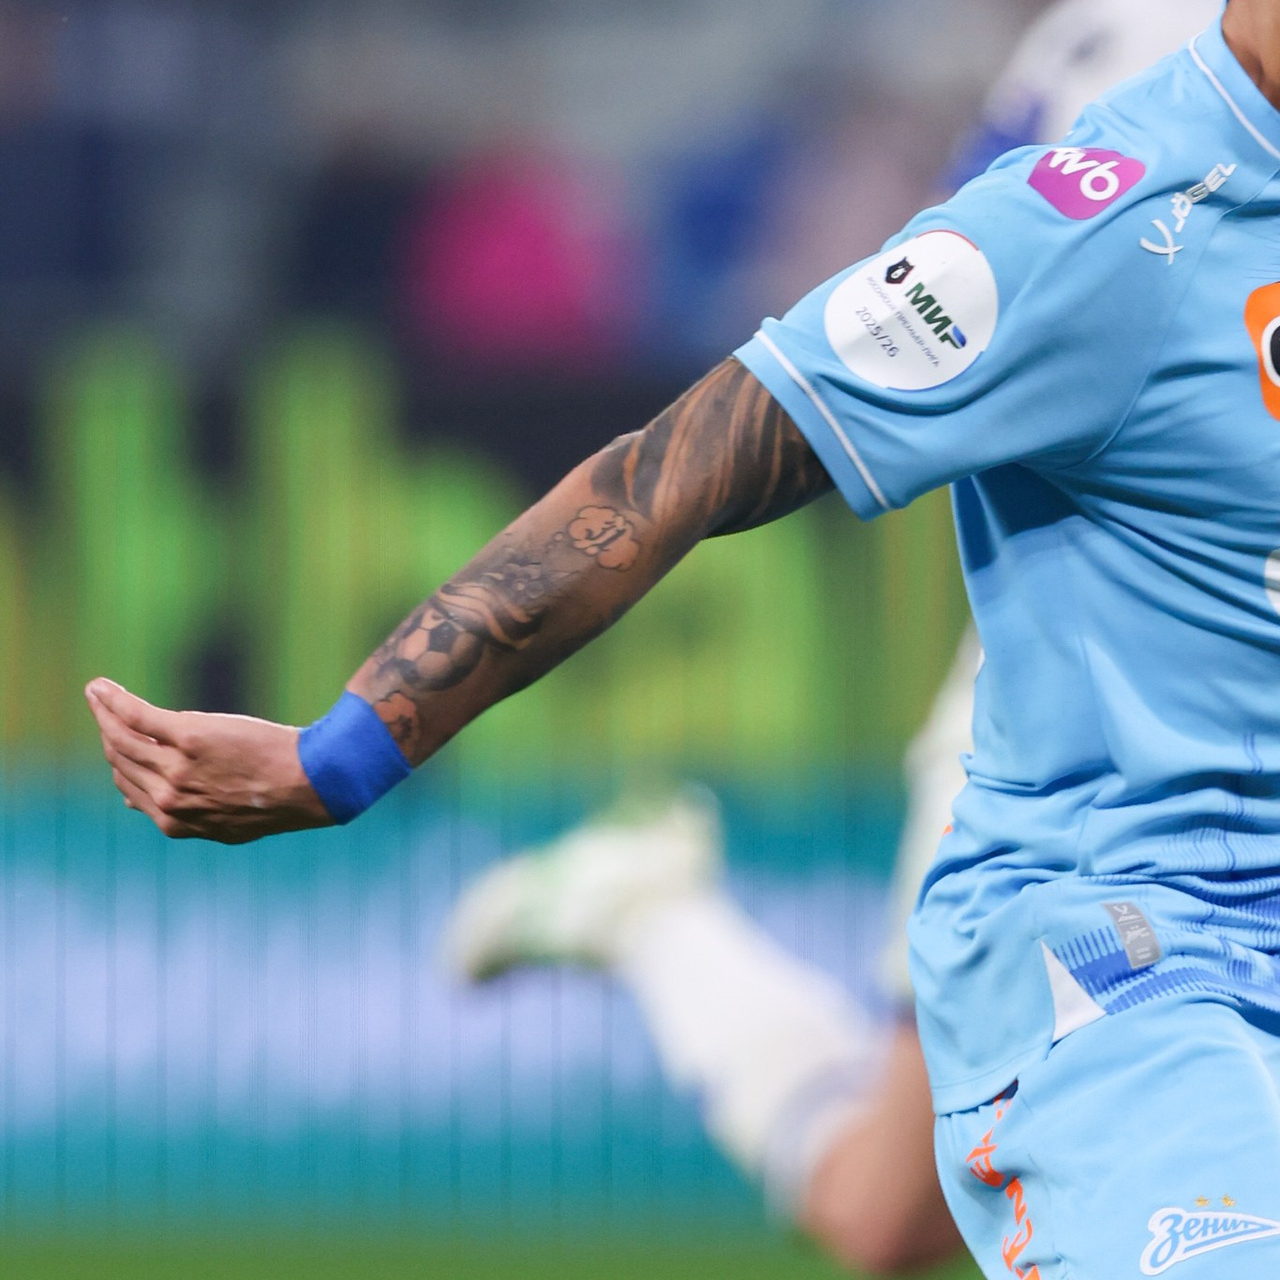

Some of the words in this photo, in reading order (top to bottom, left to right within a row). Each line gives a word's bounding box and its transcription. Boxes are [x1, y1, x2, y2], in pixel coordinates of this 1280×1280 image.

[1170, 163, 1238, 234] JÖGEL
[855, 306, 900, 358] 2025/26
[905, 281, 967, 350] МИР
